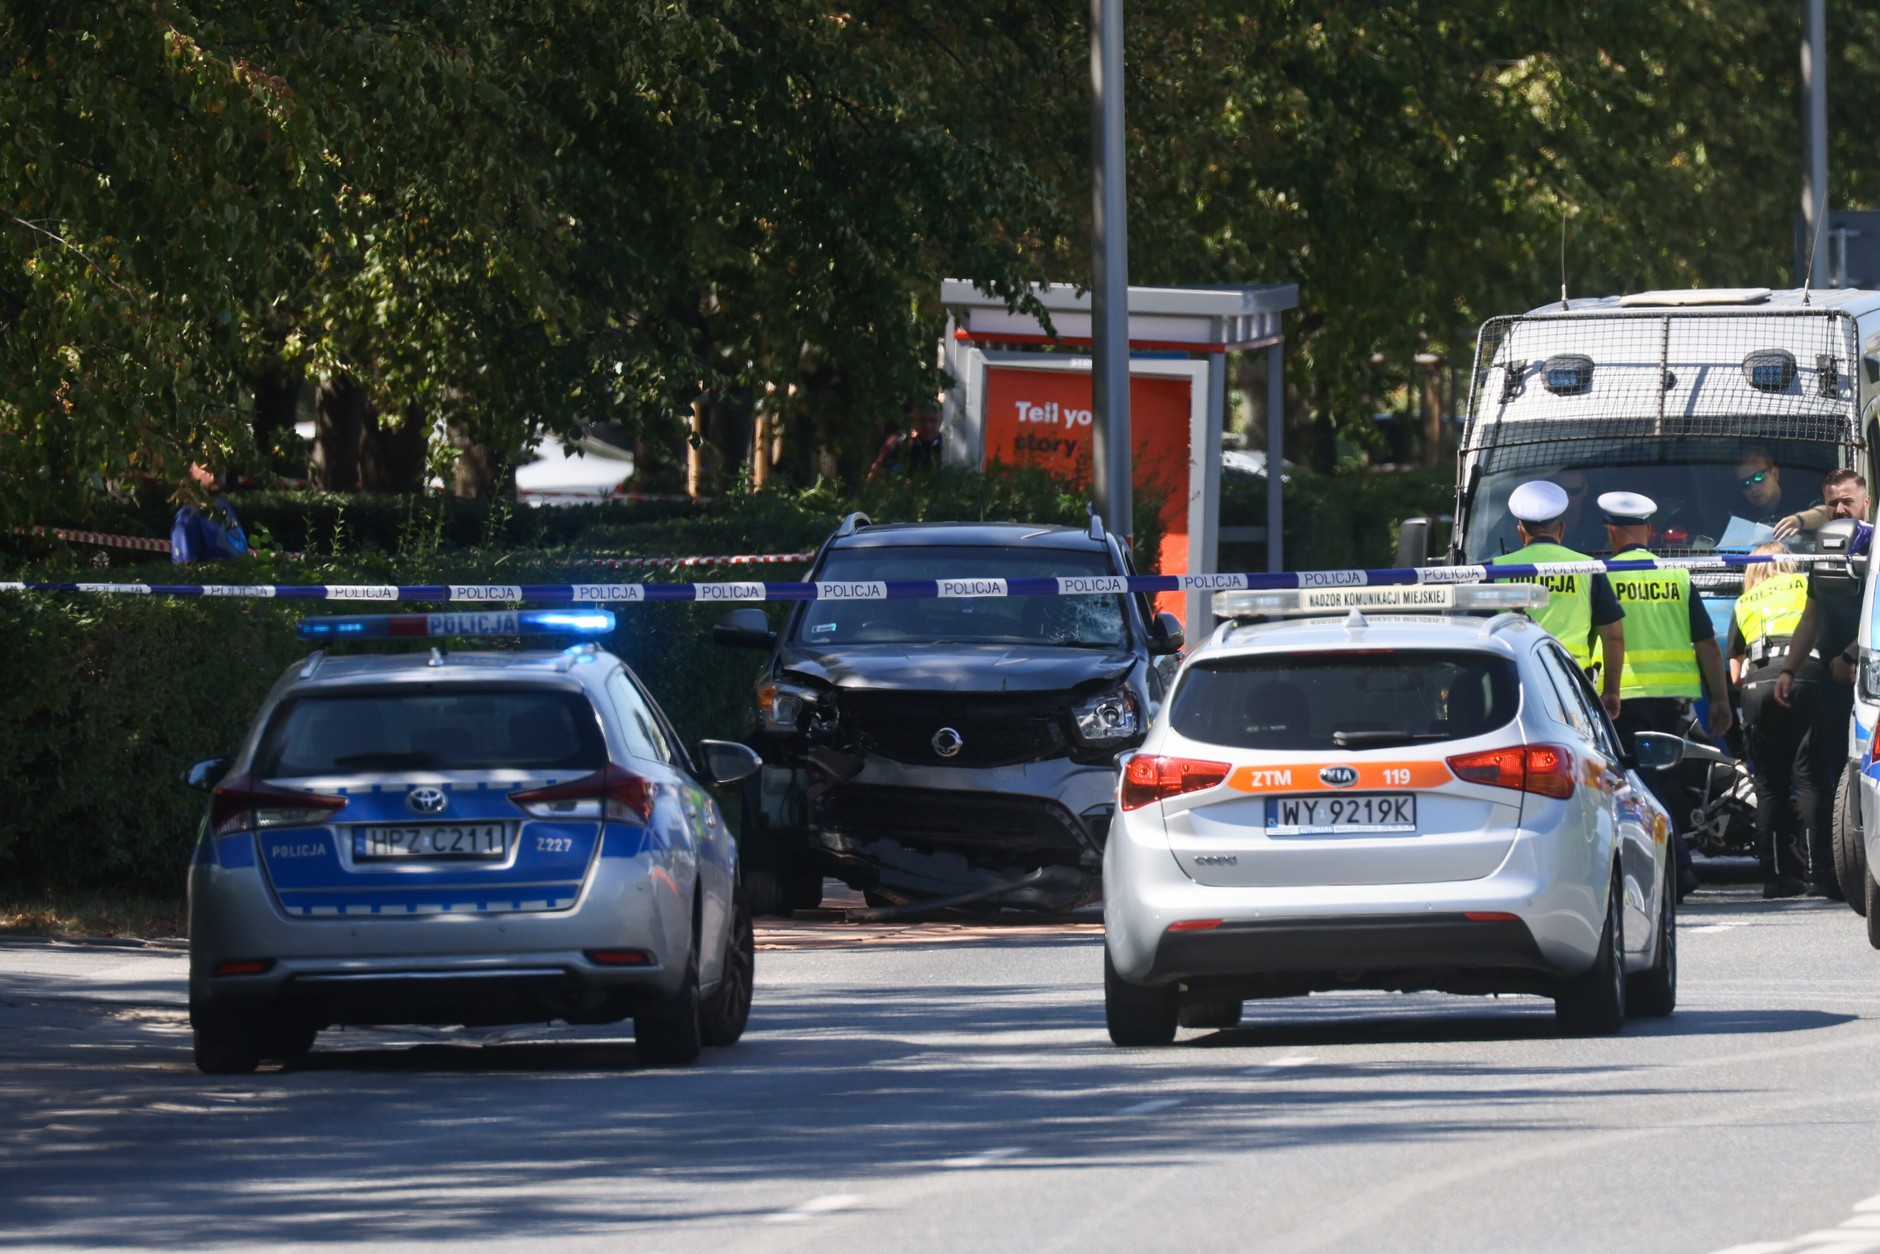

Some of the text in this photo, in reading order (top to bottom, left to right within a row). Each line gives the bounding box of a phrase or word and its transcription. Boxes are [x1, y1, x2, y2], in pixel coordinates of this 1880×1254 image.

[1015, 401, 1093, 429] Tell yo
[1014, 433, 1078, 459] story
[335, 587, 391, 599] POLICJA
[457, 587, 515, 599] POLICJA
[579, 586, 638, 599] POLICJA
[702, 585, 759, 599] POLICJA
[823, 584, 881, 598] POLICJA
[943, 581, 1001, 595] POLICJA
[1064, 579, 1122, 593] POLICJA
[1184, 575, 1242, 589] POLICJA
[1304, 573, 1361, 586] POLICJA
[1423, 568, 1480, 581] POLICJA
[1615, 582, 1681, 600] POLICJA
[1739, 579, 1804, 608] POLICJA
[1344, 591, 1401, 606] KOMUNIKACJI
[1403, 590, 1446, 605] MIEJSKIEJ
[430, 614, 518, 636] POLICJA
[1251, 769, 1292, 787] ZTM
[1326, 769, 1353, 781] KIA
[1382, 768, 1411, 785] 119
[1282, 797, 1410, 826] WY 9219K
[272, 842, 326, 858] POLICJA
[371, 826, 494, 856] HPZ C211
[536, 837, 573, 852] Z227
